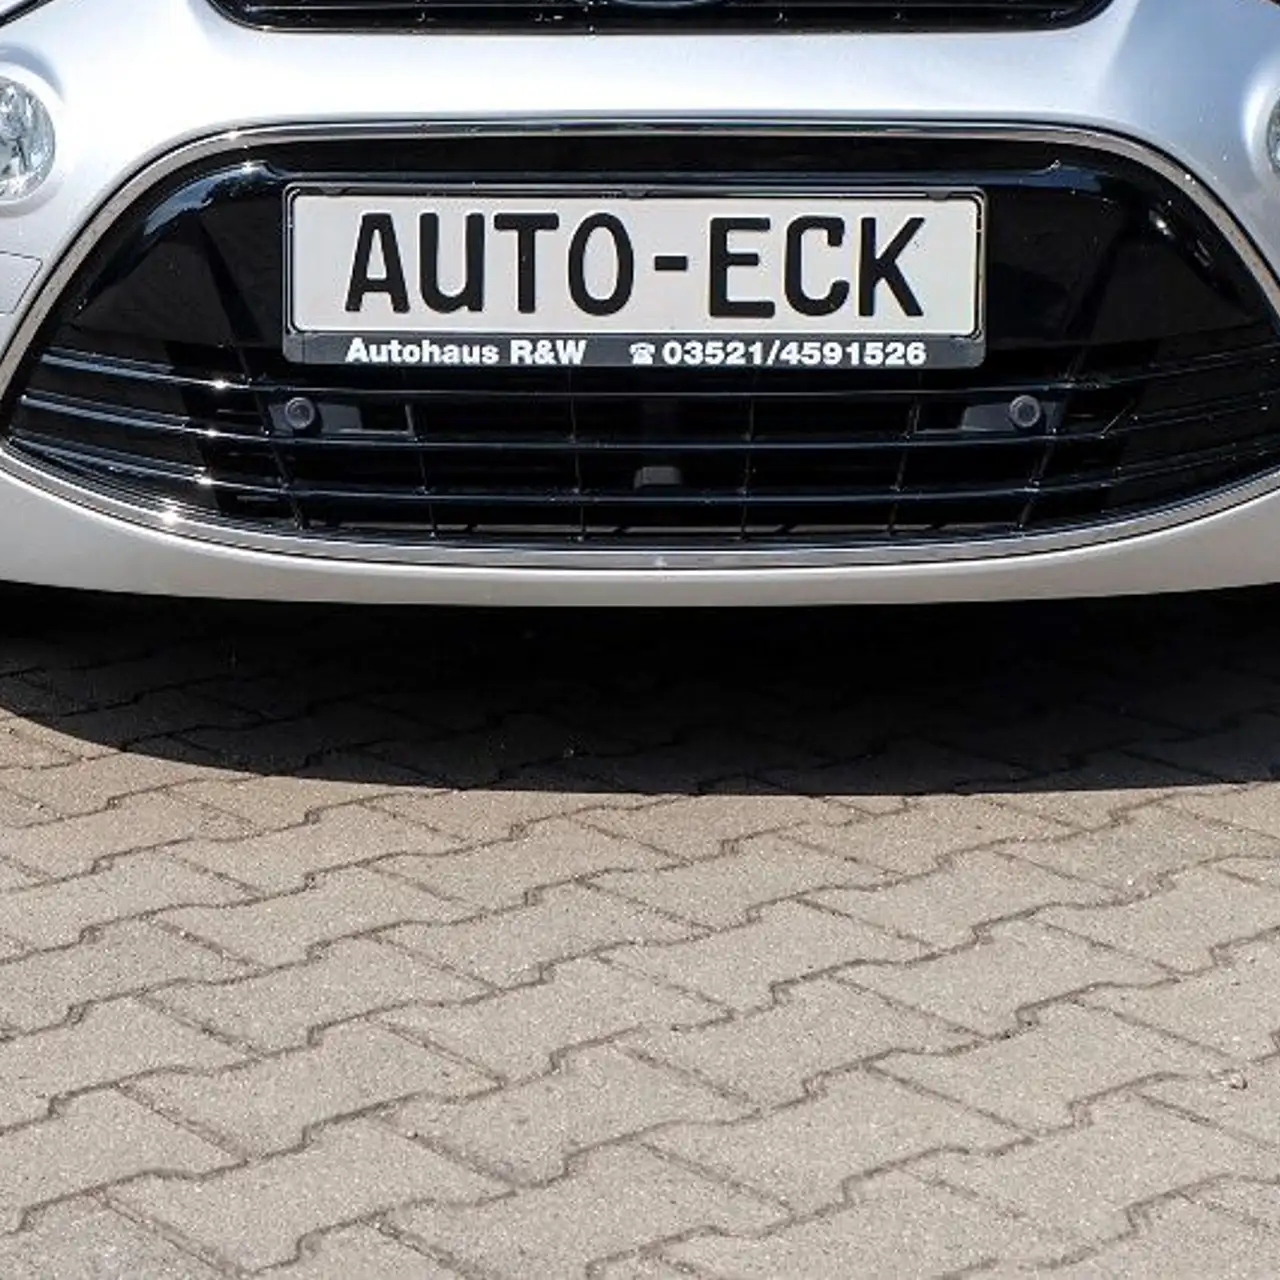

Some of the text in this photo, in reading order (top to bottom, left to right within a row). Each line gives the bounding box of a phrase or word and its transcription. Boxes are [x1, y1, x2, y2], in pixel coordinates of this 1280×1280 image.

[345, 213, 926, 317] AUTO-ECK
[345, 338, 927, 366] Autohaus R&W 03521/4591526
